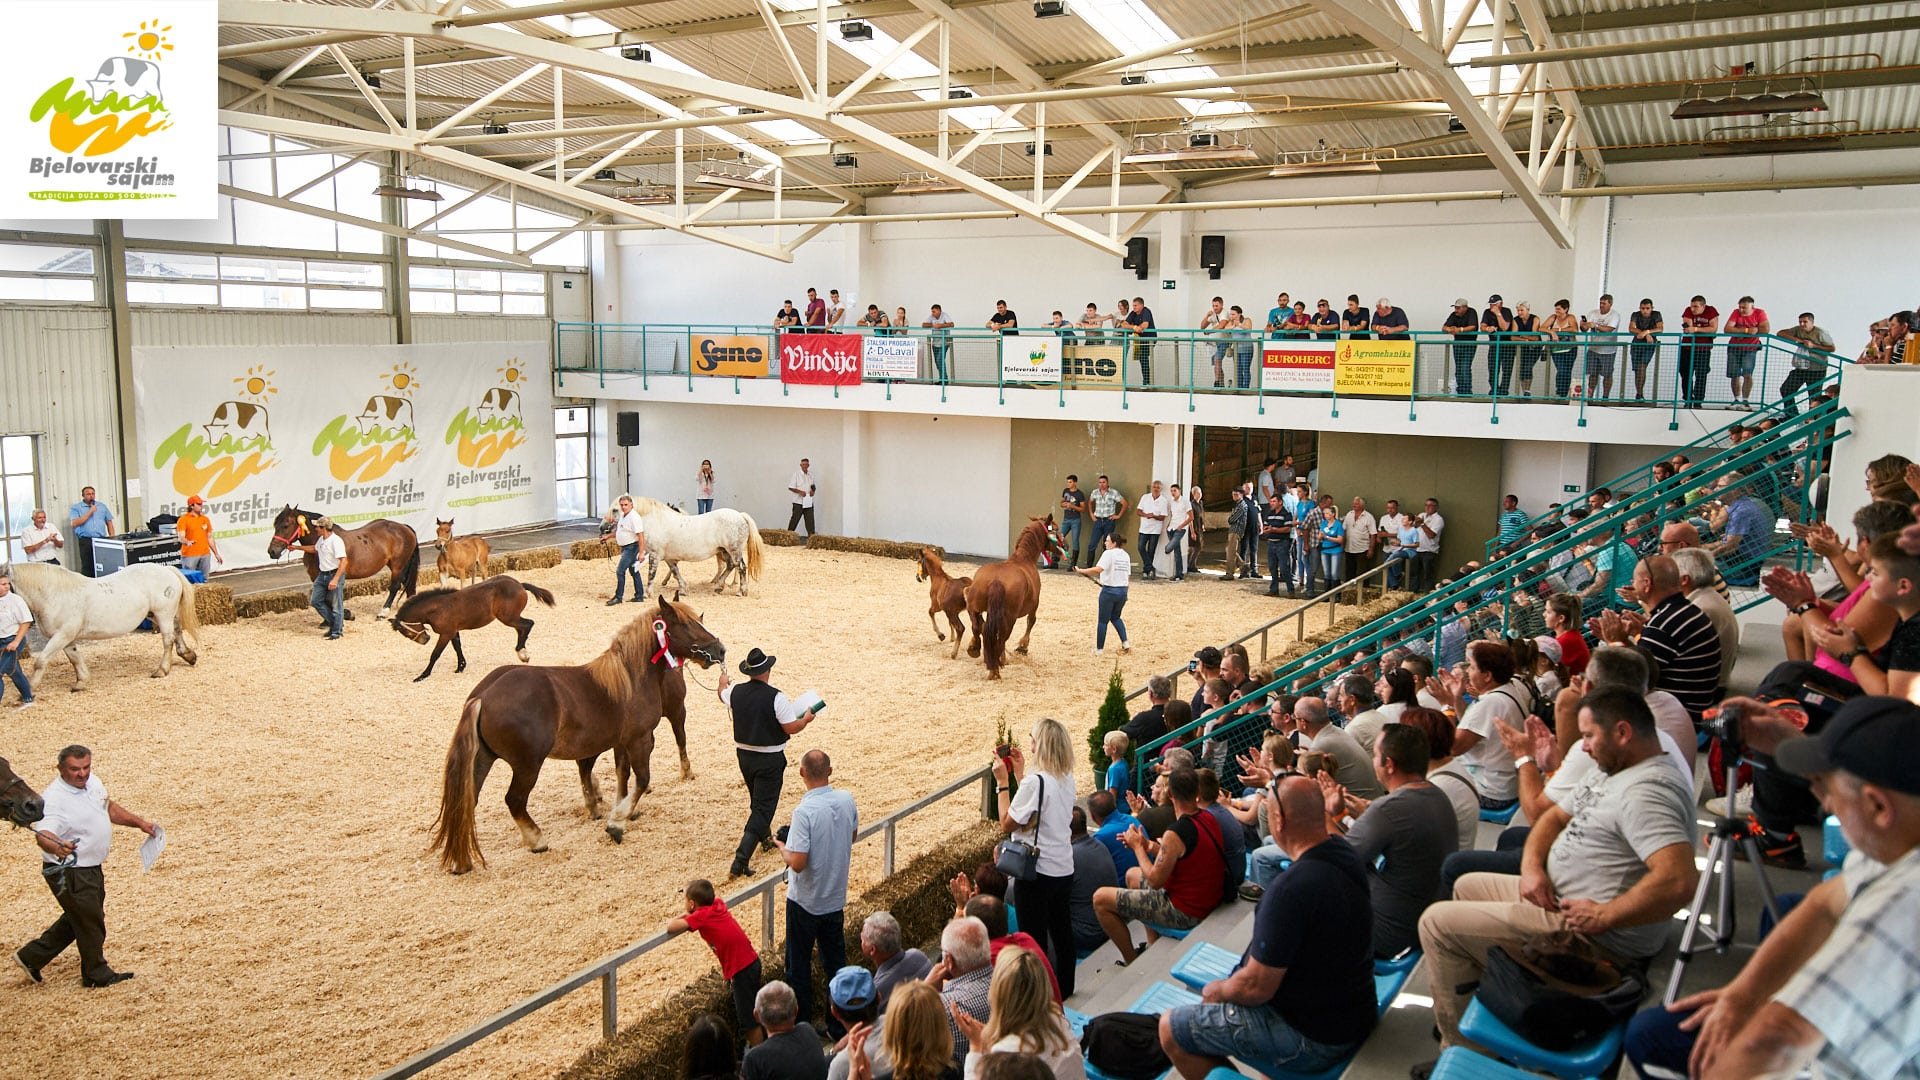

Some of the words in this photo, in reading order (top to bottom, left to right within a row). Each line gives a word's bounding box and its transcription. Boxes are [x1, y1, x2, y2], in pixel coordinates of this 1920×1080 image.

[696, 339, 763, 371] Sano
[784, 345, 858, 375] Vindija
[877, 346, 914, 356] DeLaval
[1267, 354, 1331, 365] EUROHERC
[1353, 350, 1411, 359] Agromehanika
[447, 464, 521, 489] Bjelovarski
[493, 476, 532, 491] sajam
[314, 478, 414, 505] Bjelovarski
[377, 491, 425, 508] sajam
[160, 492, 270, 515] Bjeovarski
